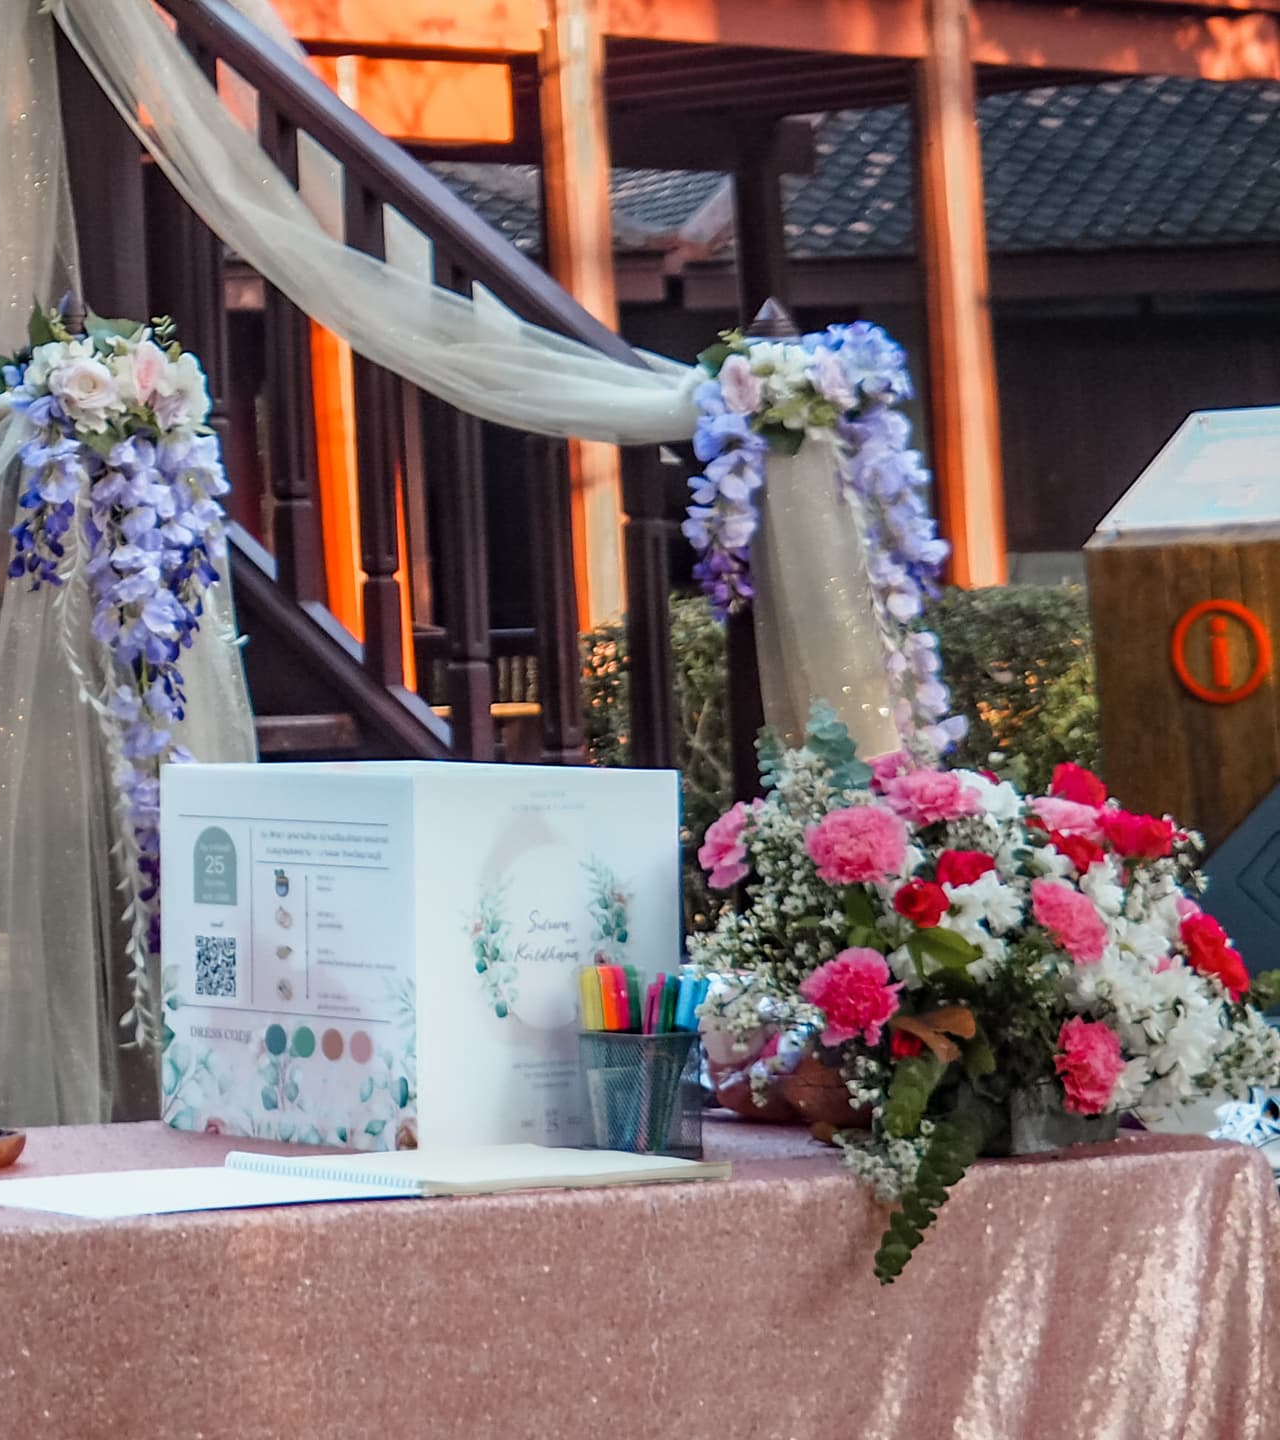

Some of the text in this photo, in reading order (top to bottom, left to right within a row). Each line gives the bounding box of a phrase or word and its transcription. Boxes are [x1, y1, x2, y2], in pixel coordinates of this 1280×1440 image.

[204, 854, 226, 875] 25
[190, 1025, 253, 1046] DRESS CODE
